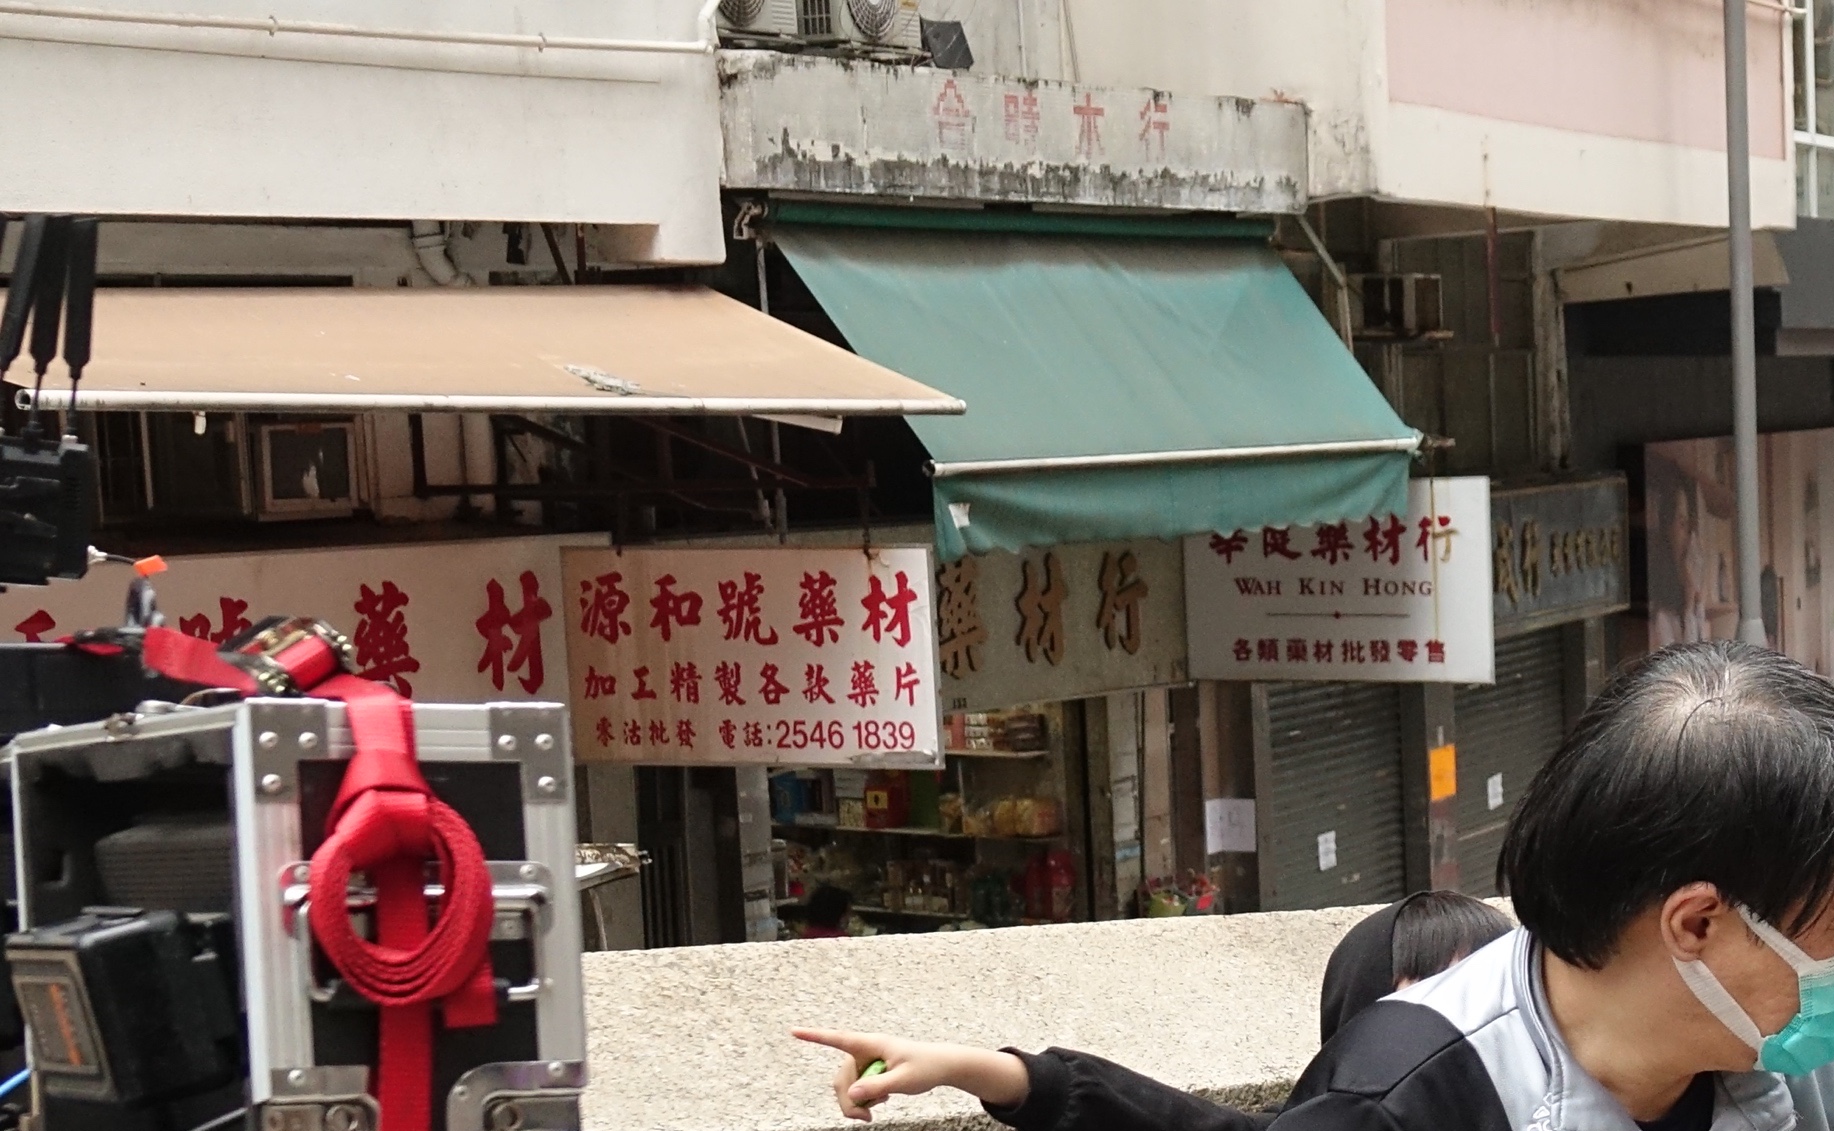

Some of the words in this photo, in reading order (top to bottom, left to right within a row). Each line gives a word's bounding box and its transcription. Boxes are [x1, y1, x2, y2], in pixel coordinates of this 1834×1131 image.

[1234, 577, 1282, 597] WAH
[1299, 577, 1345, 597] KIN
[1363, 577, 1433, 598] HONG
[579, 570, 918, 649] 源和號藥材
[1232, 638, 1446, 664] 各類藥材批發零售
[584, 661, 921, 708] 加工精製各款藥片
[596, 719, 697, 751] 零沽批發
[718, 719, 845, 751] 電話:2546
[853, 719, 915, 750] 1839
